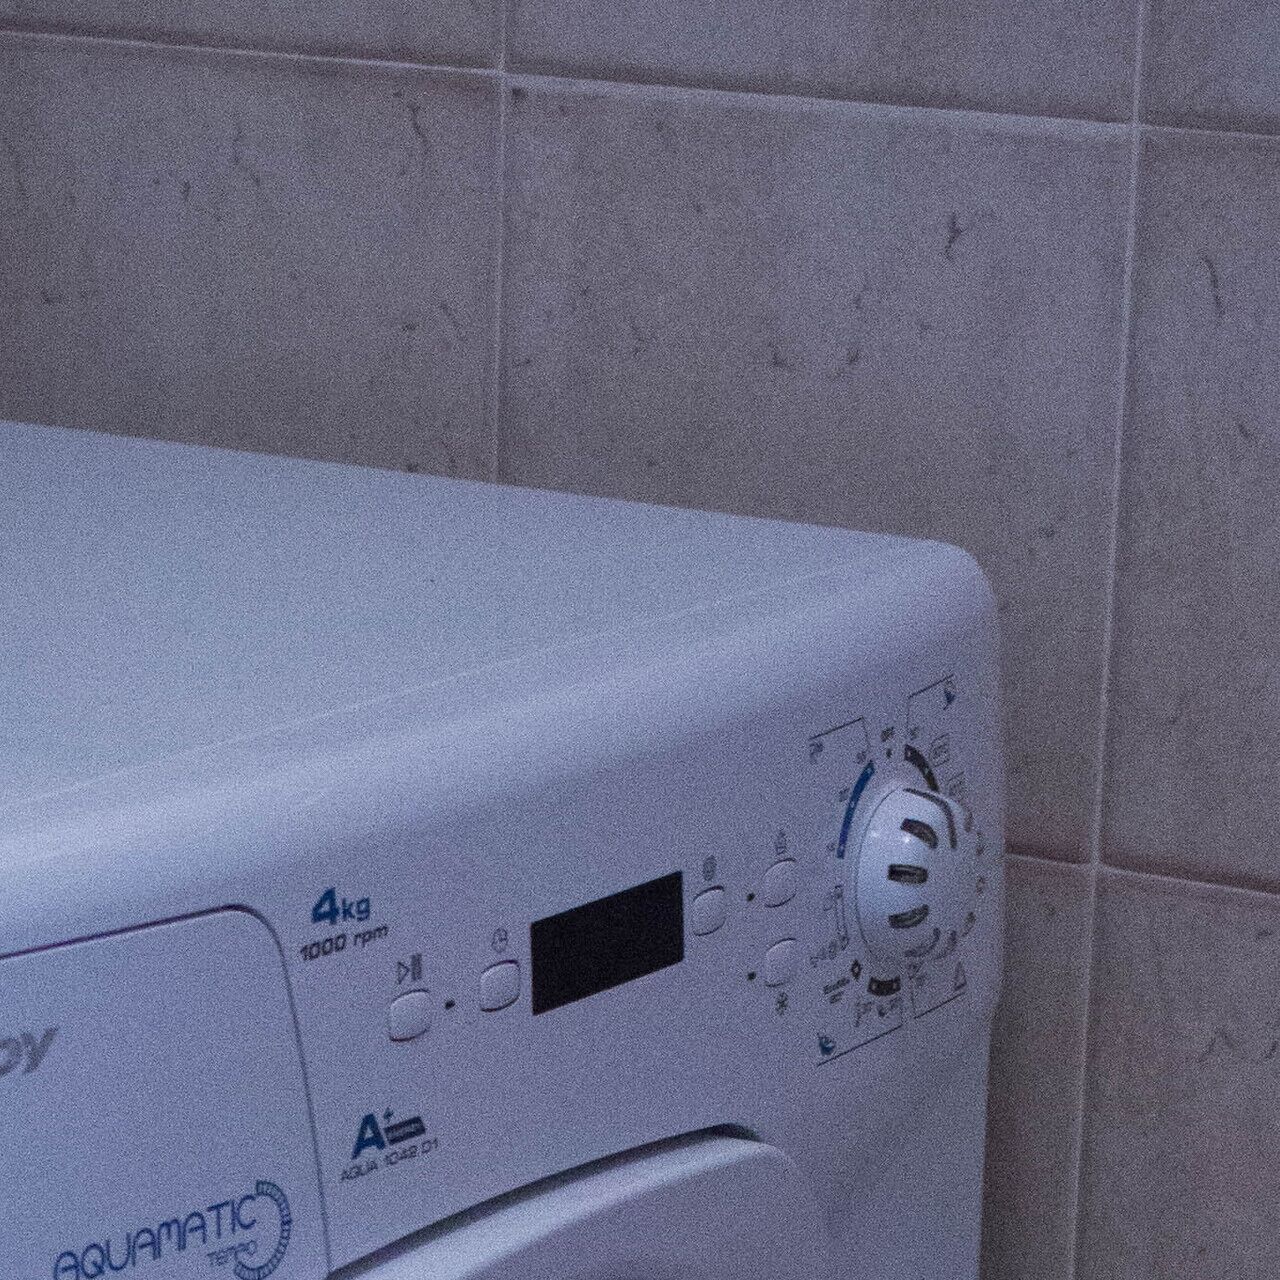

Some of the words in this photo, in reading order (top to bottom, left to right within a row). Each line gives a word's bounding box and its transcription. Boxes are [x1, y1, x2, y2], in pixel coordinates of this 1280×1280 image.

[311, 887, 371, 925] 4kg
[300, 935, 347, 961] 1000
[352, 925, 388, 949] rpm
[340, 1160, 378, 1182] AQUA
